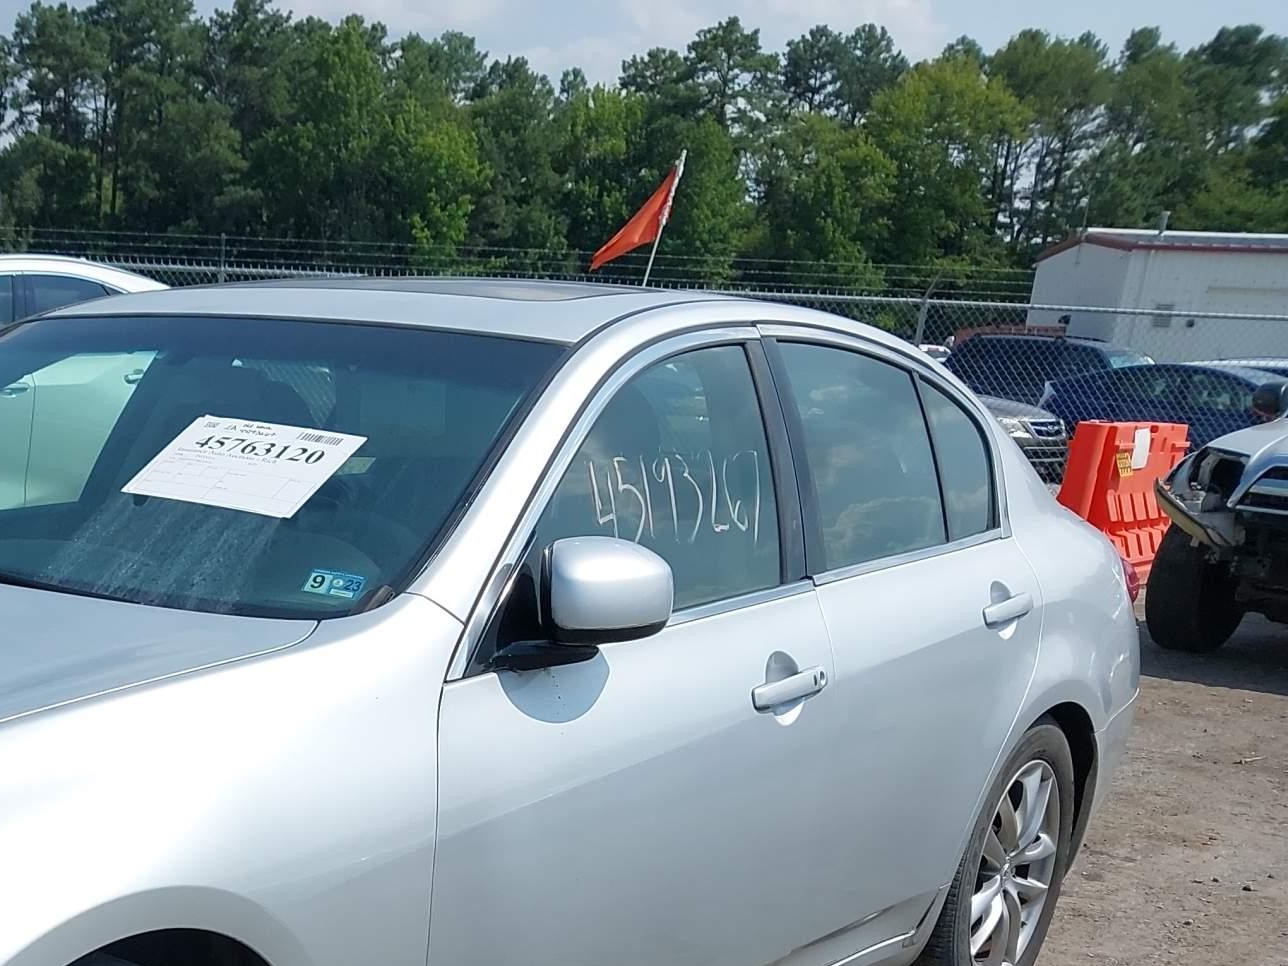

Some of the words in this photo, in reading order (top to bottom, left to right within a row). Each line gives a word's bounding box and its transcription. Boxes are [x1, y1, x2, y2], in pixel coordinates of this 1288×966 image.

[195, 435, 325, 465] 45763120
[310, 574, 326, 589] 9
[343, 579, 362, 592] 23
